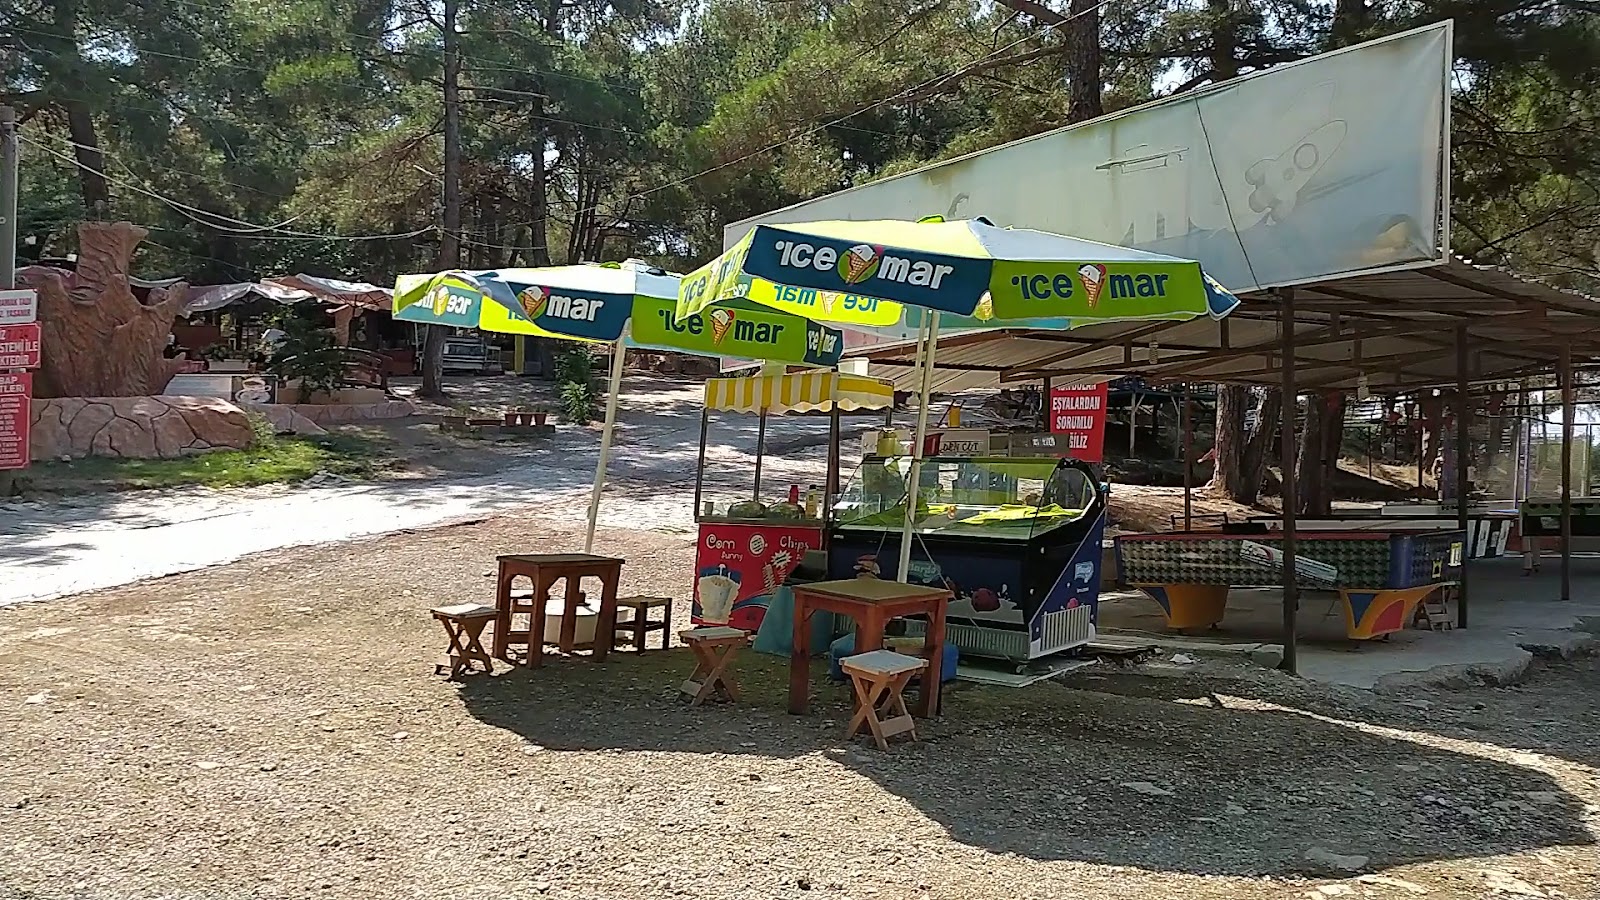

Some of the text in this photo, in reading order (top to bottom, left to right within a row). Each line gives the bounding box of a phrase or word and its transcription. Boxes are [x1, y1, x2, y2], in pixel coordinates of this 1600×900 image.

[775, 240, 954, 290] ice mar
[1011, 274, 1168, 299] ice mar
[546, 295, 605, 322] mar
[658, 309, 784, 344] ice mar
[1052, 396, 1101, 414] EŞYALARDAN
[1056, 416, 1093, 430] SORUMLU
[779, 535, 810, 552] Chips
